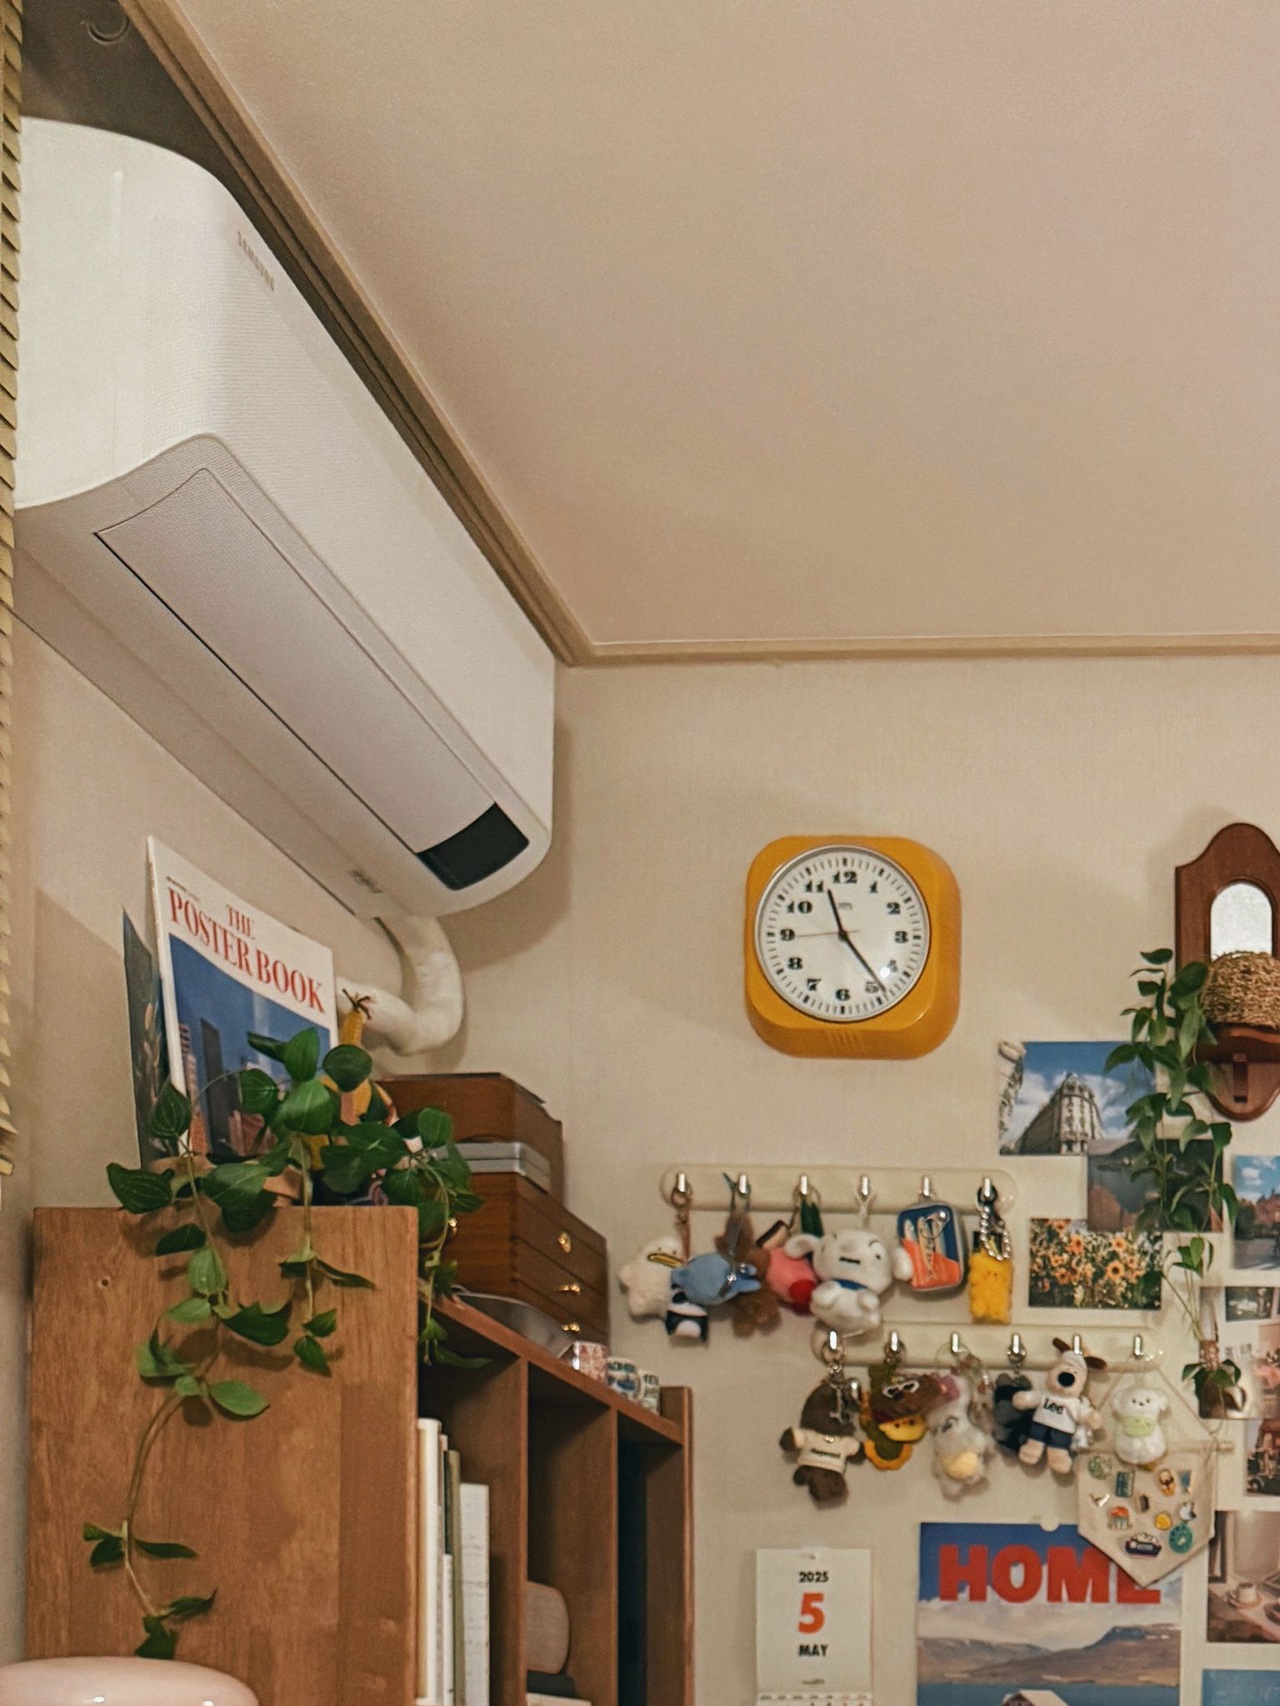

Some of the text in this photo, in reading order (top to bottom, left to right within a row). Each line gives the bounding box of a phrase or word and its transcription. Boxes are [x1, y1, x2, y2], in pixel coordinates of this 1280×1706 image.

[832, 871, 858, 884] 12
[804, 881, 825, 893] 11
[868, 881, 878, 894] 1
[786, 901, 813, 914] 10
[886, 902, 901, 915] 2
[226, 904, 256, 940] THE
[779, 928, 796, 942] 9
[894, 931, 909, 944] 3
[167, 887, 325, 1014] POSTER BOOK
[788, 957, 803, 970] 8
[807, 977, 822, 992] 7
[865, 981, 880, 994] 5
[835, 988, 851, 1001] 6
[798, 1570, 830, 1584] 2025
[797, 1591, 825, 1635] 5
[797, 1644, 830, 1658] MAY
